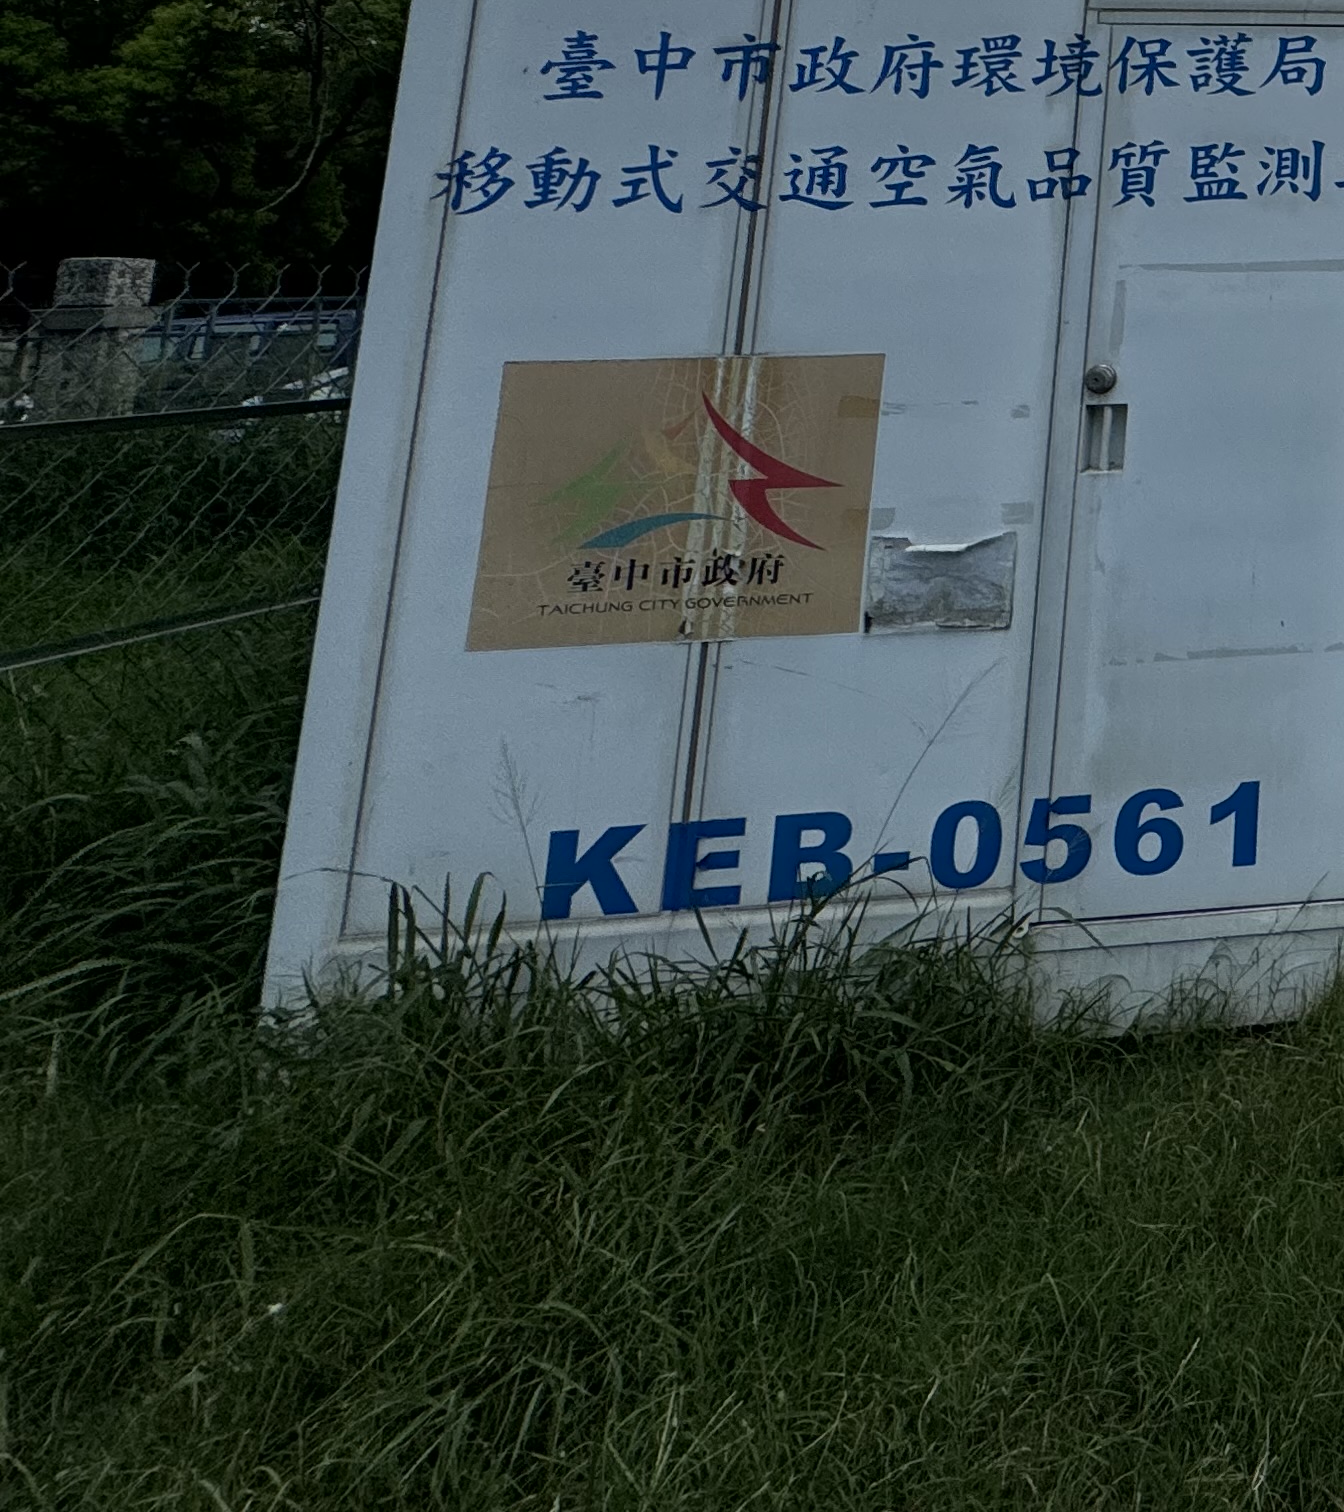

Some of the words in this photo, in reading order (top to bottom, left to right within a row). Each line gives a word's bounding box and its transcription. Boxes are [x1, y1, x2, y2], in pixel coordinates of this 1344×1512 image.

[540, 30, 1329, 102] 臺中市政府環境保護局
[566, 549, 785, 594] 臺中市政府
[537, 598, 634, 617] TAICHUNG
[638, 597, 682, 612] CITY
[685, 592, 814, 610] GOVERNMENT
[541, 780, 1262, 920] KEB-0561
